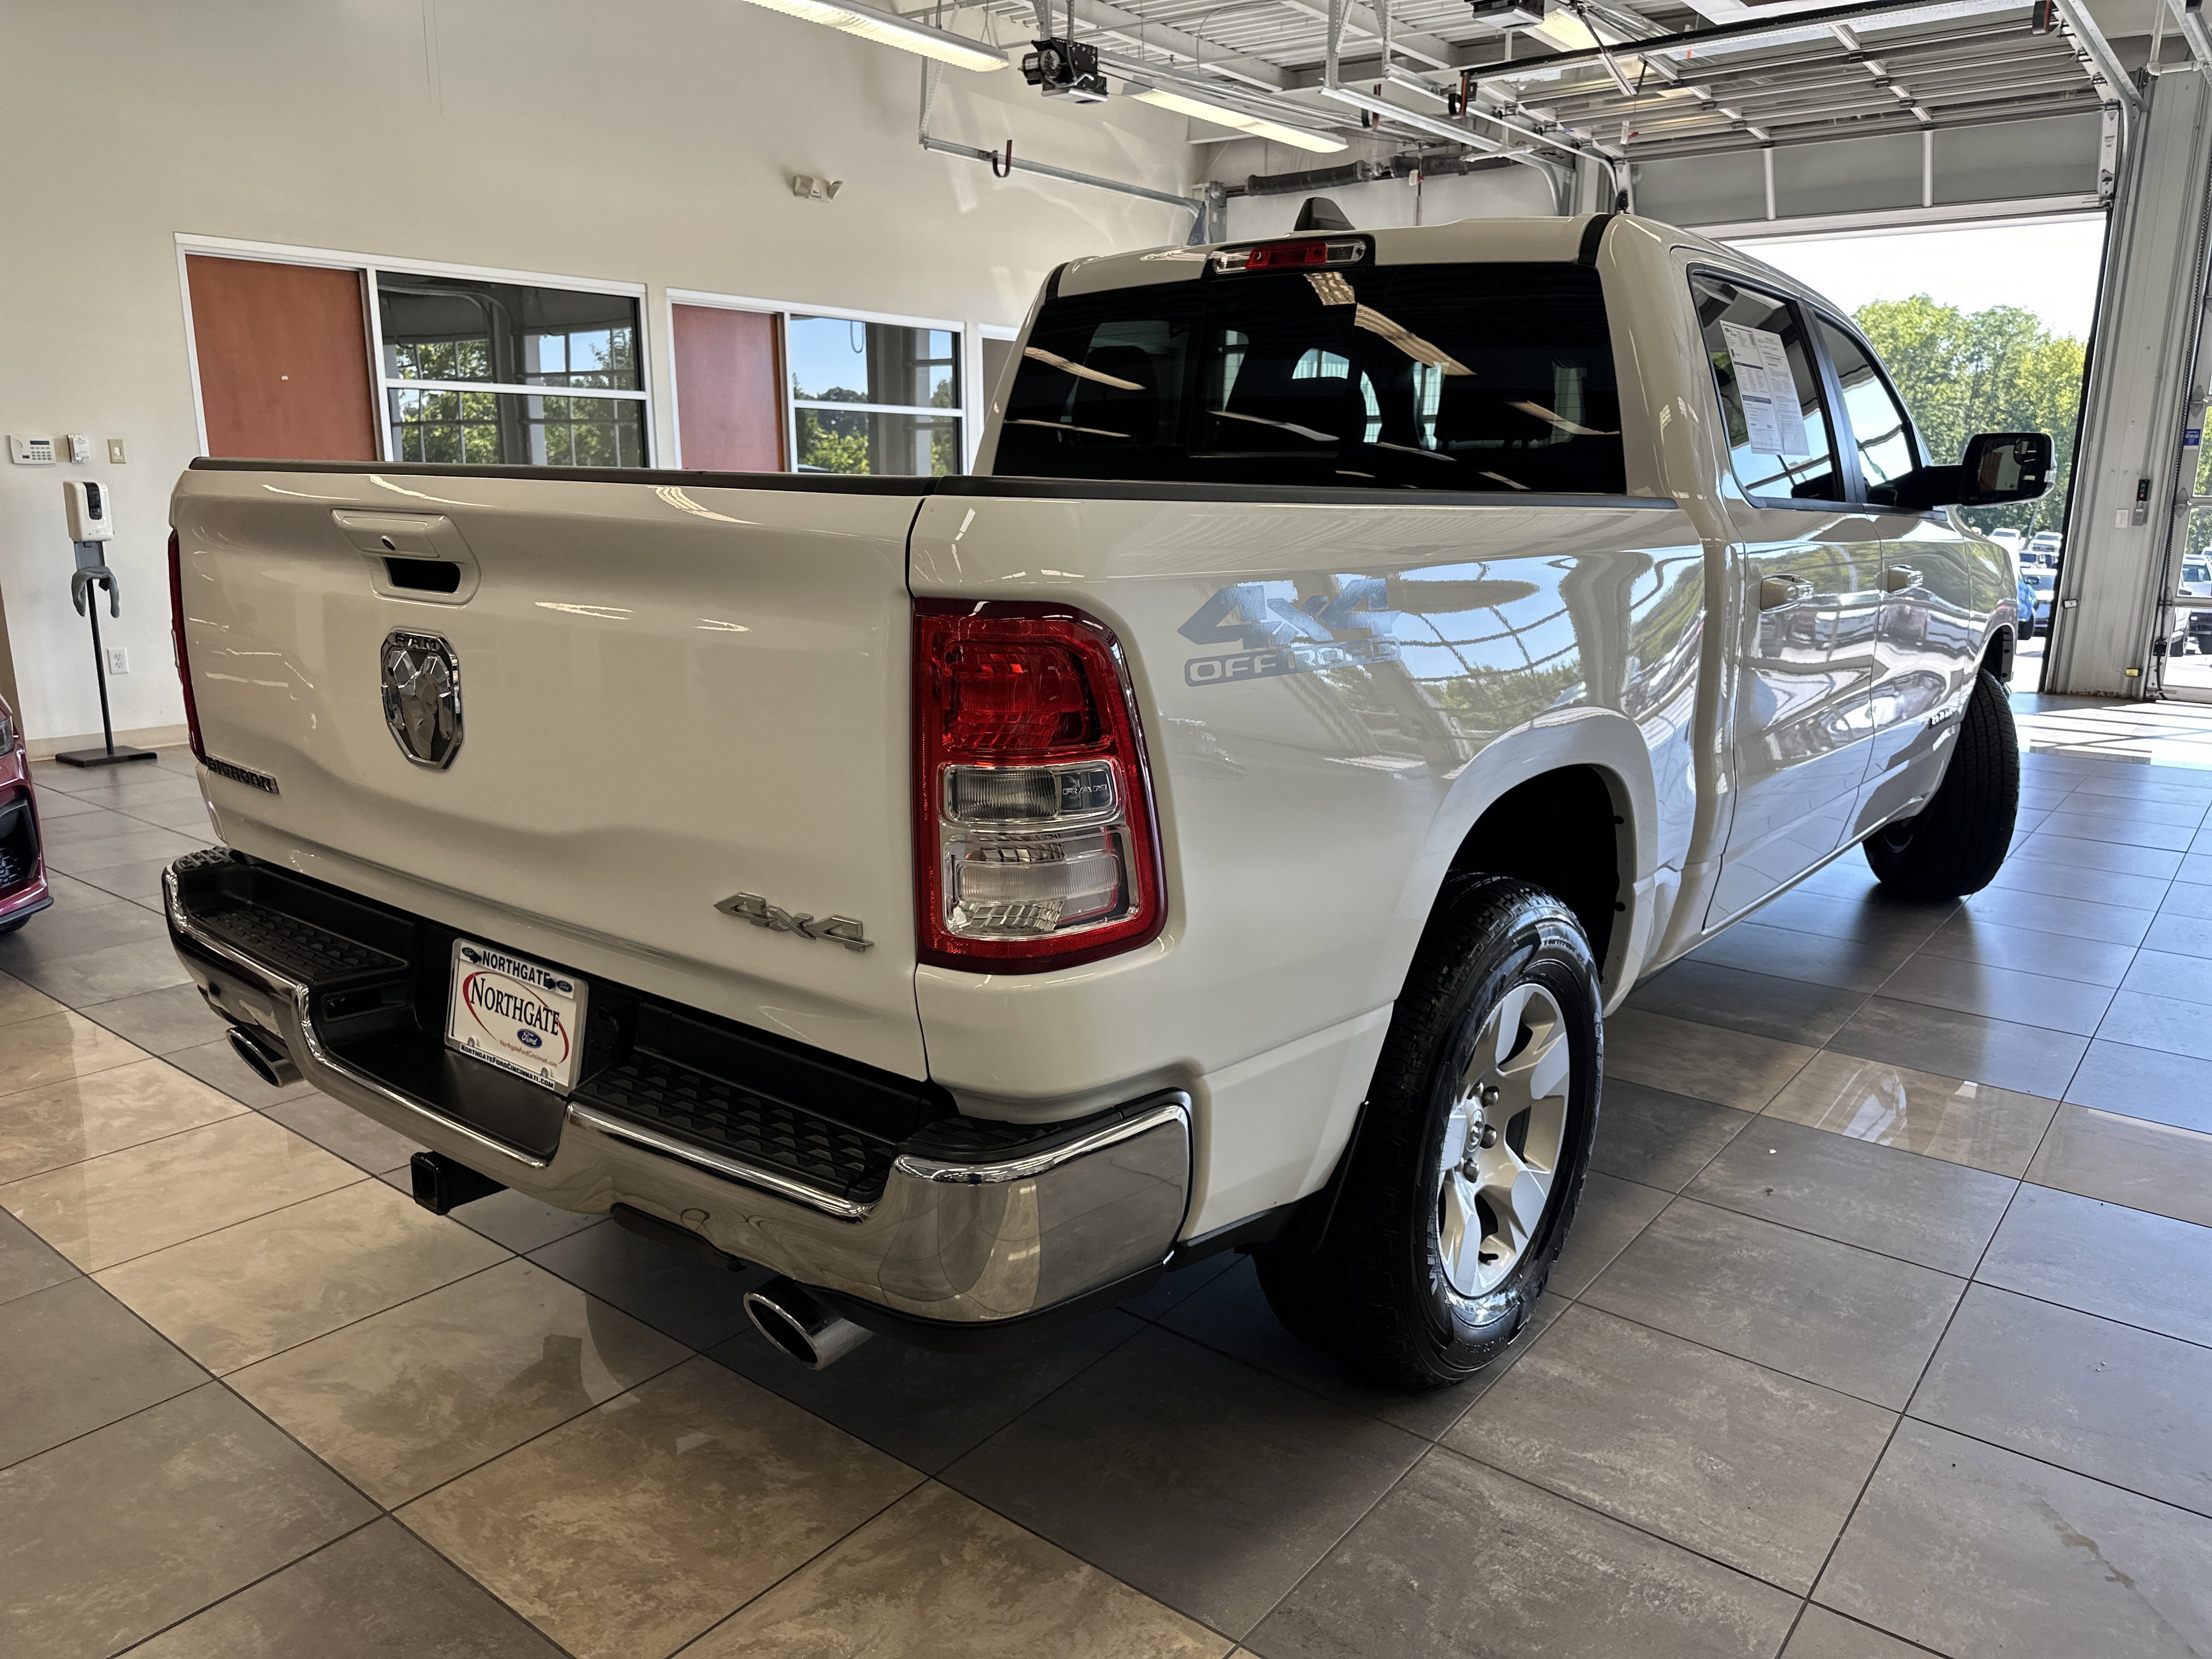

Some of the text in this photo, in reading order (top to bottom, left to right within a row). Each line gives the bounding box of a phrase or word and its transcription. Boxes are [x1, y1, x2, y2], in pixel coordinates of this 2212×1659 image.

[1189, 641, 1394, 681] OFF ROAD
[1063, 784, 1107, 795] RAM
[483, 950, 550, 988] NORTHGATE
[522, 1031, 538, 1046] Ford
